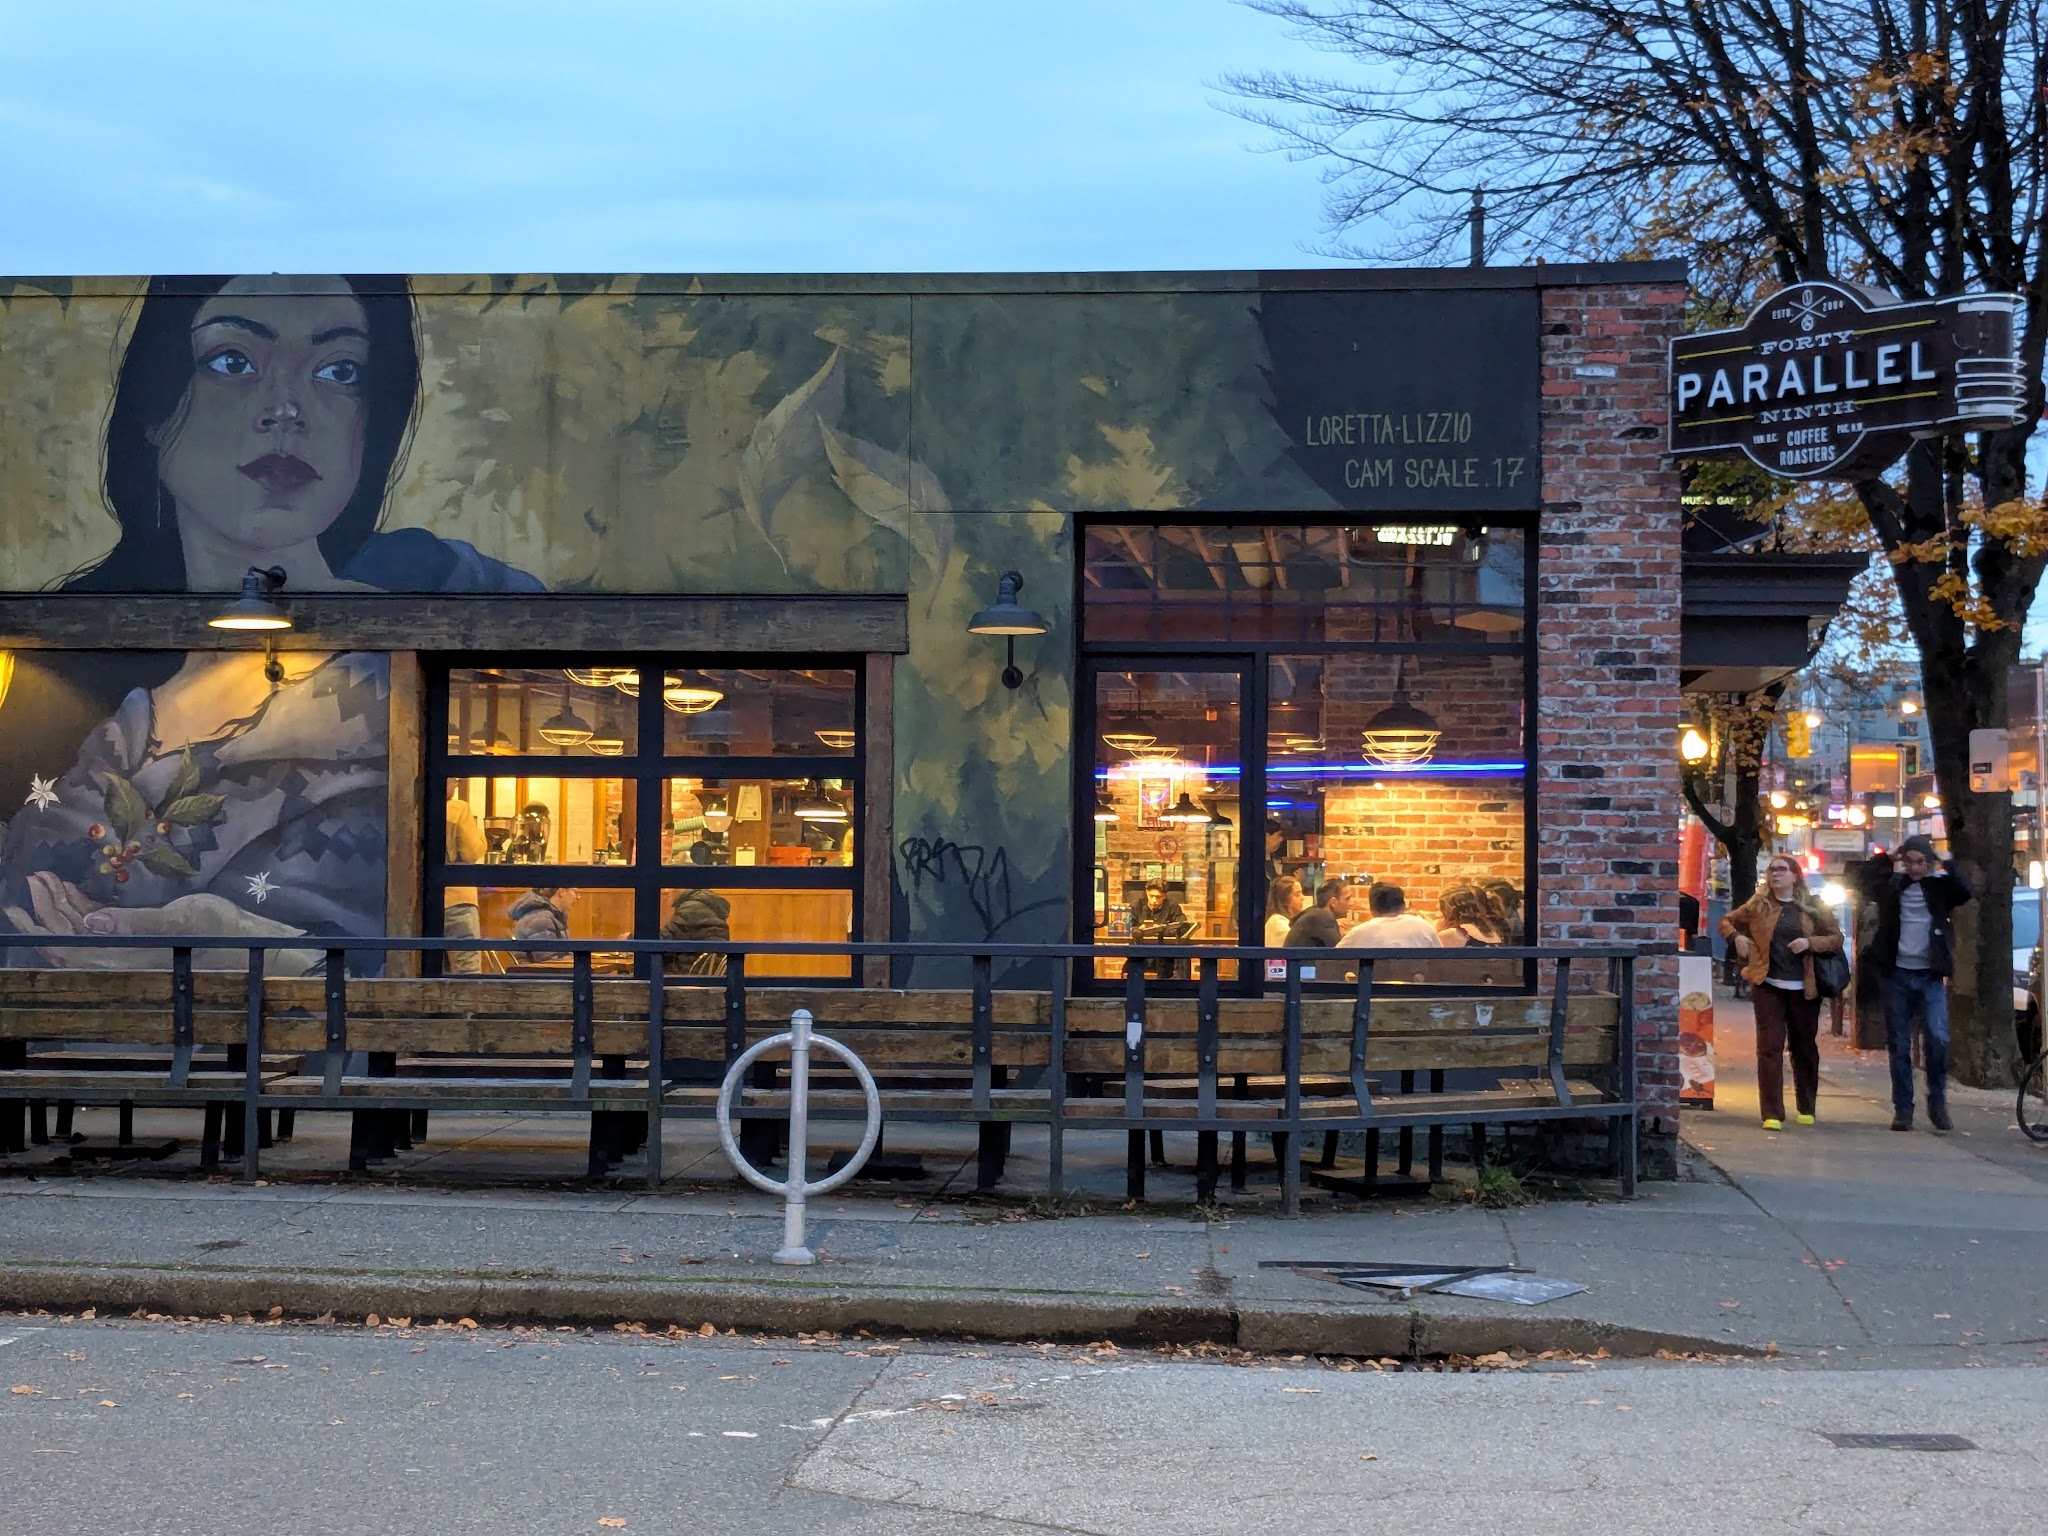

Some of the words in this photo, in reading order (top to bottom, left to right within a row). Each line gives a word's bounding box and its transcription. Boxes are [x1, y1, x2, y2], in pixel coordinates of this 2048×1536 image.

[1760, 329, 1854, 357] FORTY
[1677, 340, 1936, 412] PARALLEL
[1760, 400, 1855, 424] NINTH
[1786, 426, 1829, 447] COFFEE
[1779, 445, 1836, 466] ROASTERS
[1345, 458, 1394, 488] CAM
